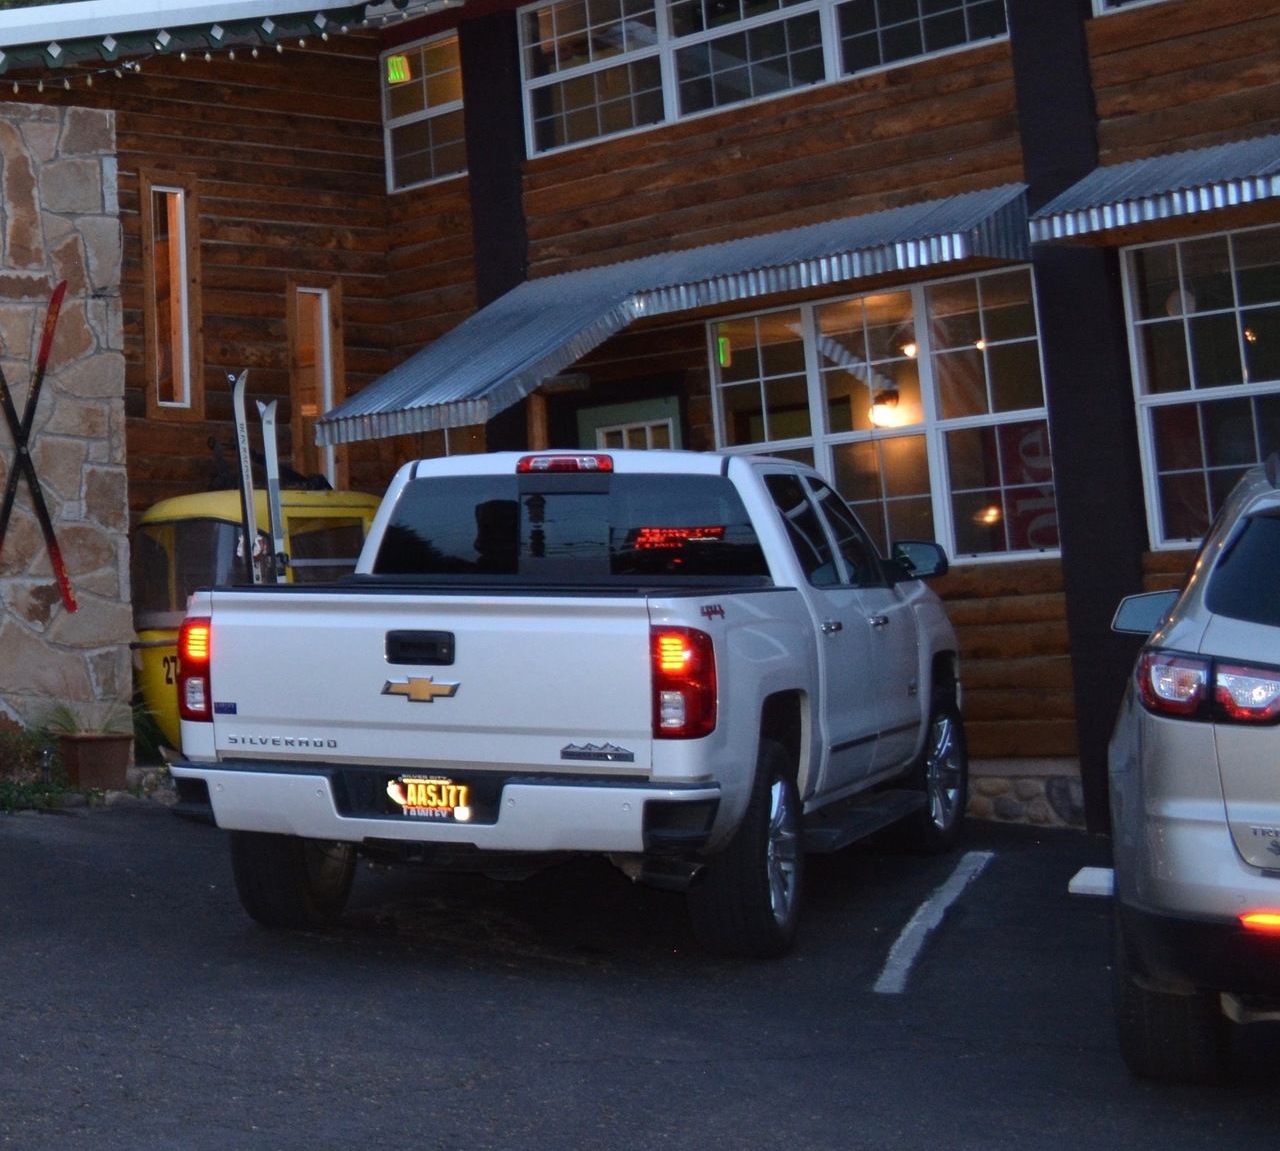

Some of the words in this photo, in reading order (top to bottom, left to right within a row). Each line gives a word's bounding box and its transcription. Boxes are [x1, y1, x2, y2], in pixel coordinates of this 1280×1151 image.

[1011, 418, 1057, 550] oke
[227, 732, 338, 749] SILVERADO
[406, 783, 469, 809] AASJ77
